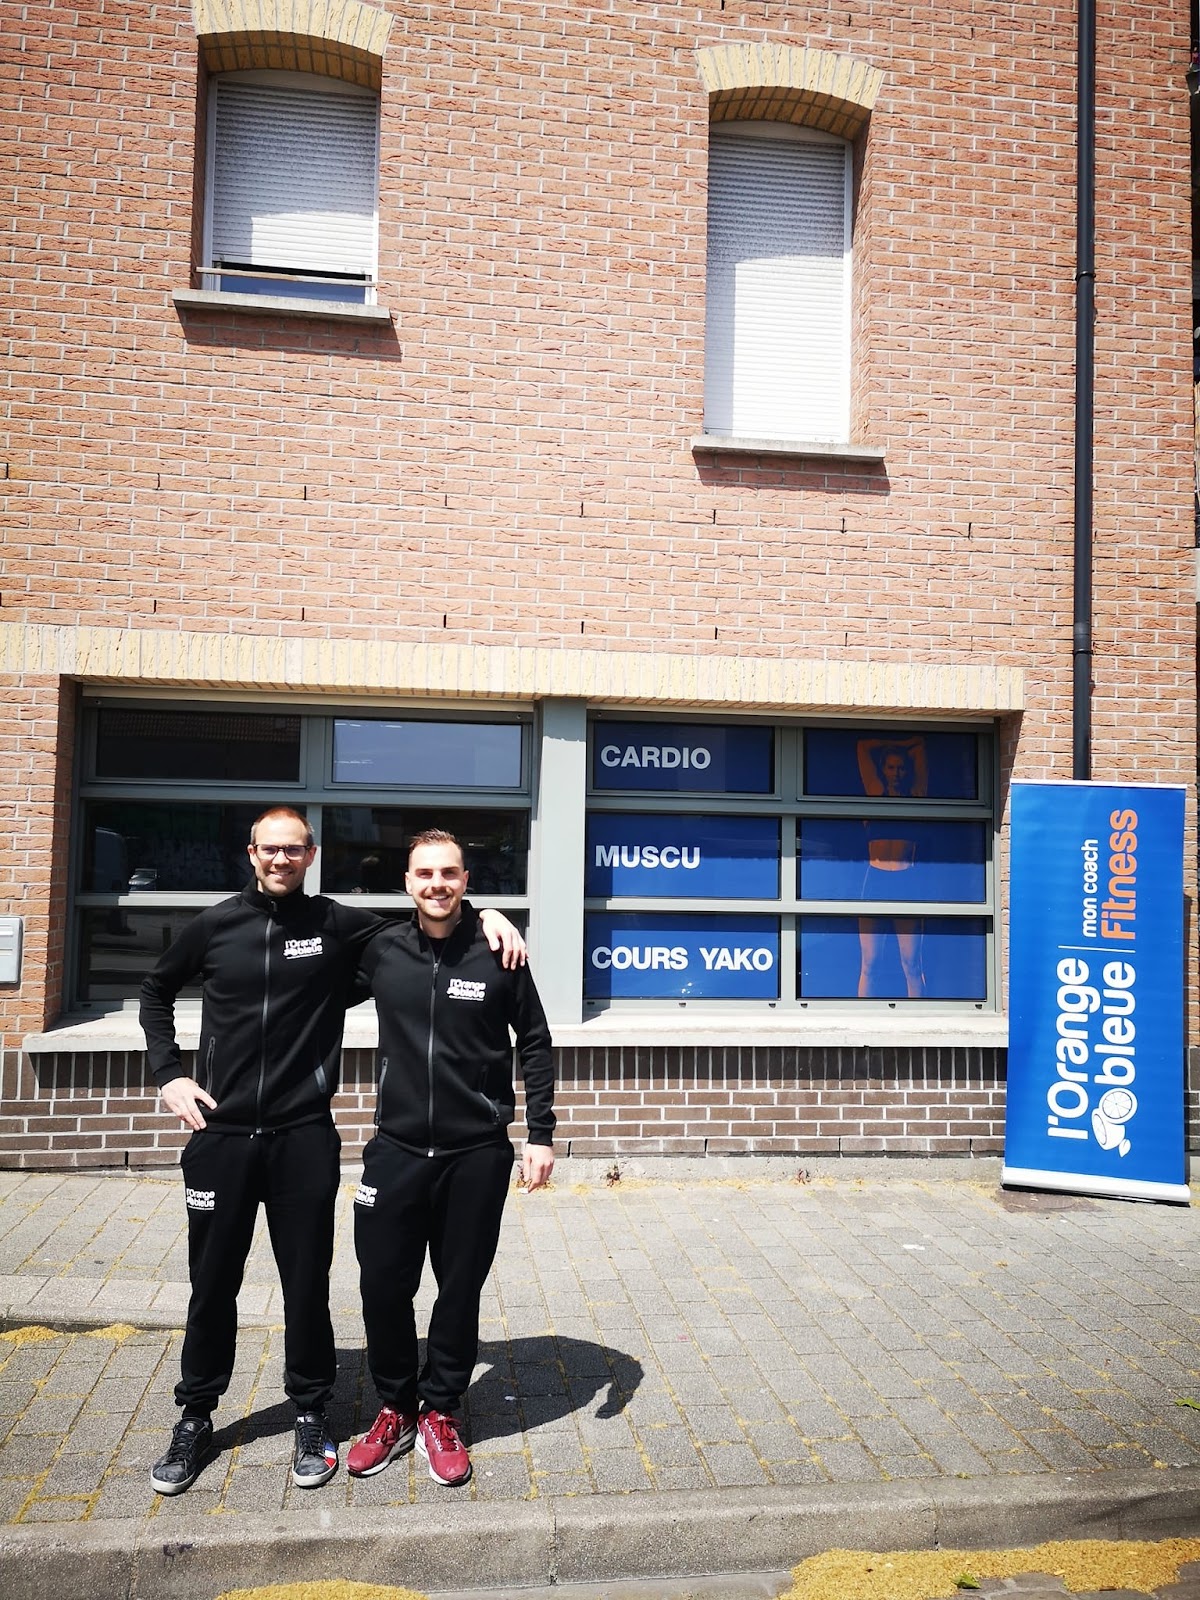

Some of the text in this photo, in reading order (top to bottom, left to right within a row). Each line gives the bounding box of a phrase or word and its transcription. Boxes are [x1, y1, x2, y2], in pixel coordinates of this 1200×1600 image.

[600, 745, 711, 769] CARDIO
[596, 844, 701, 869] MUSCU
[1081, 839, 1099, 938] mon coach
[1101, 808, 1138, 940] Fitness
[591, 946, 774, 971] COURS YAKO
[1047, 957, 1101, 1140] l'Orange
[1094, 961, 1136, 1086] bleue
